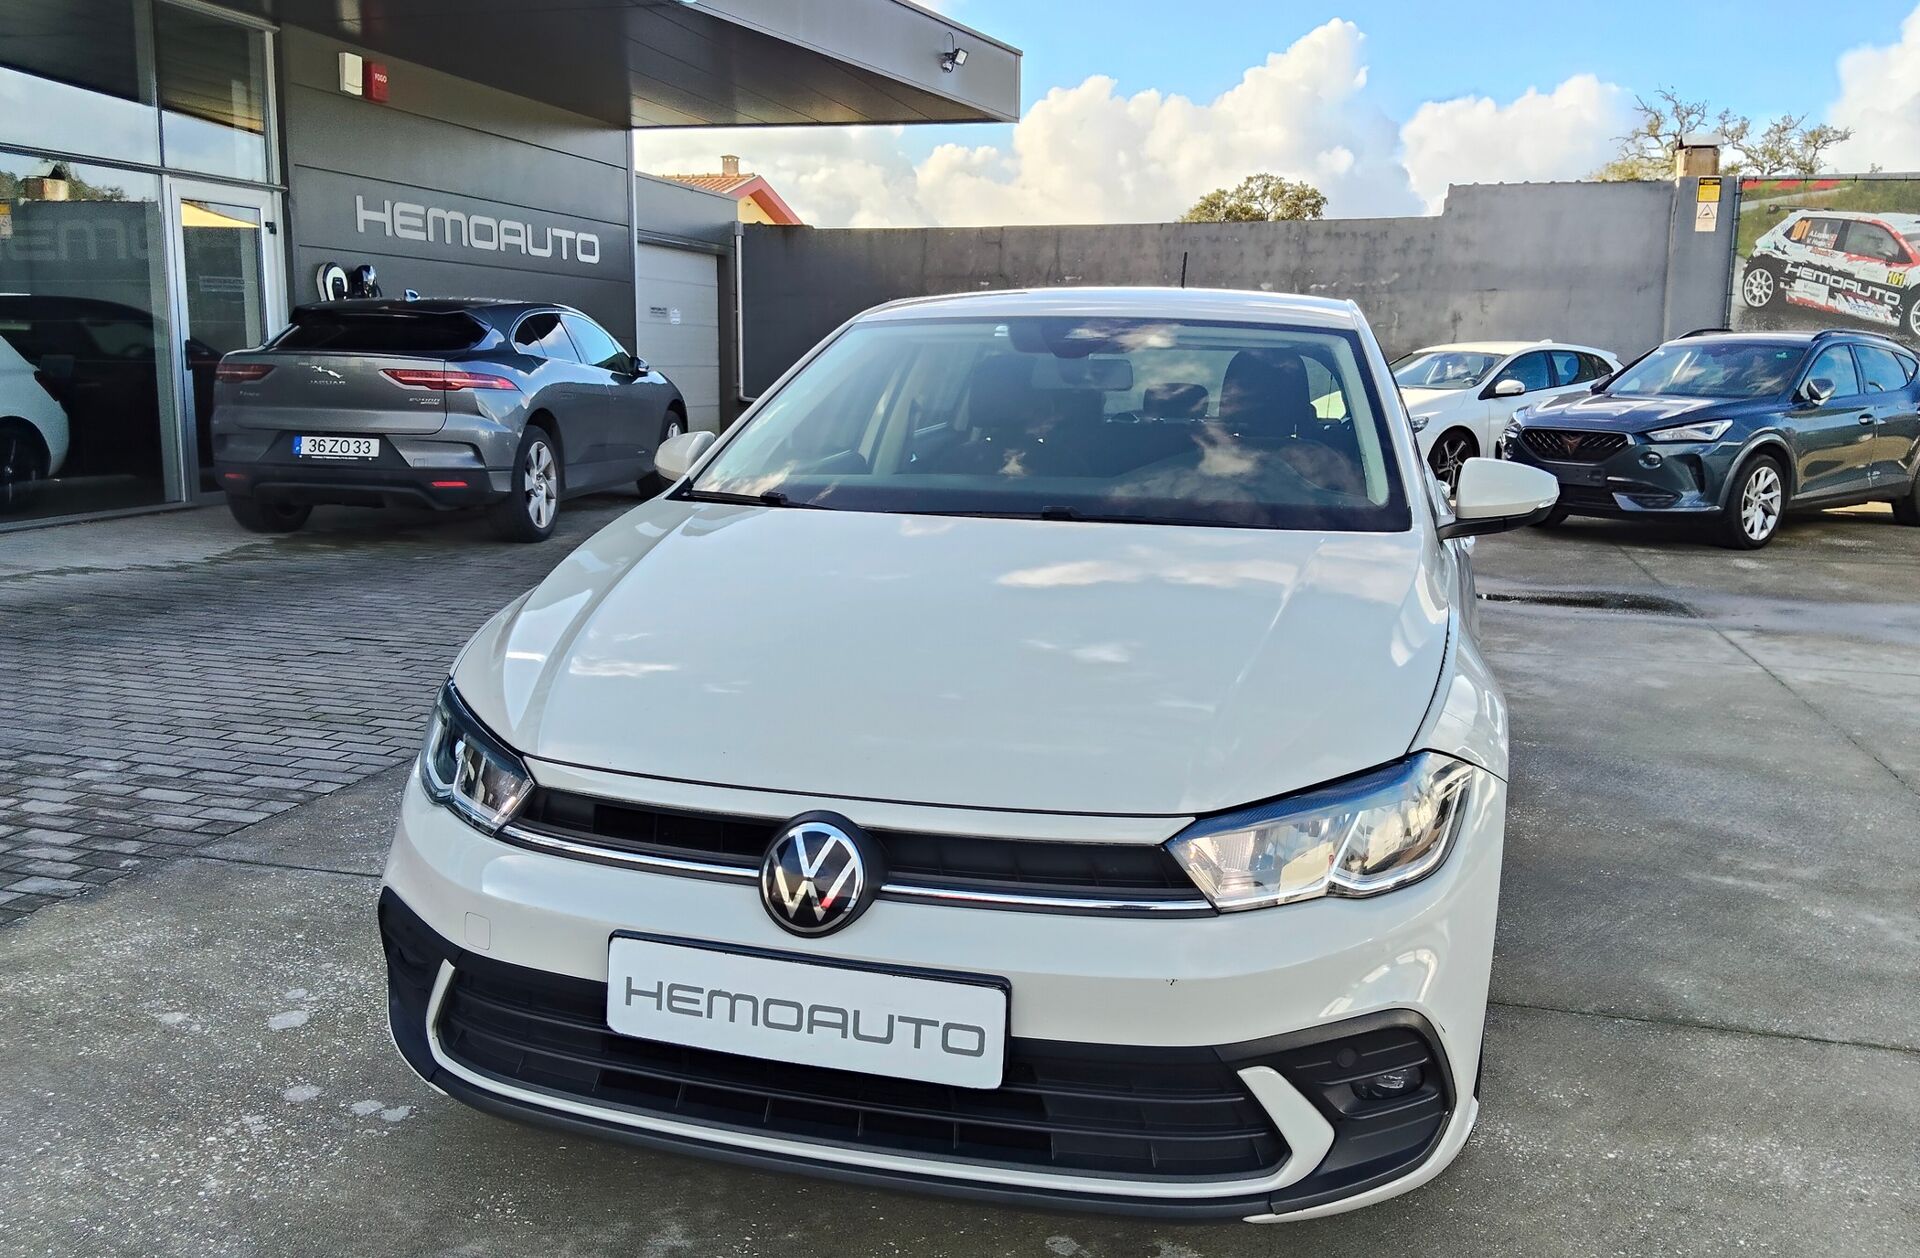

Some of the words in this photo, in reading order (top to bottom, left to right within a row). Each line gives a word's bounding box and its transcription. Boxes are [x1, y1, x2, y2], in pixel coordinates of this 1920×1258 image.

[356, 194, 601, 265] HEMOAUTO
[1785, 263, 1901, 306] HEMOAUTO
[1887, 270, 1905, 286] 101
[624, 975, 987, 1058] HEMOAUTO
